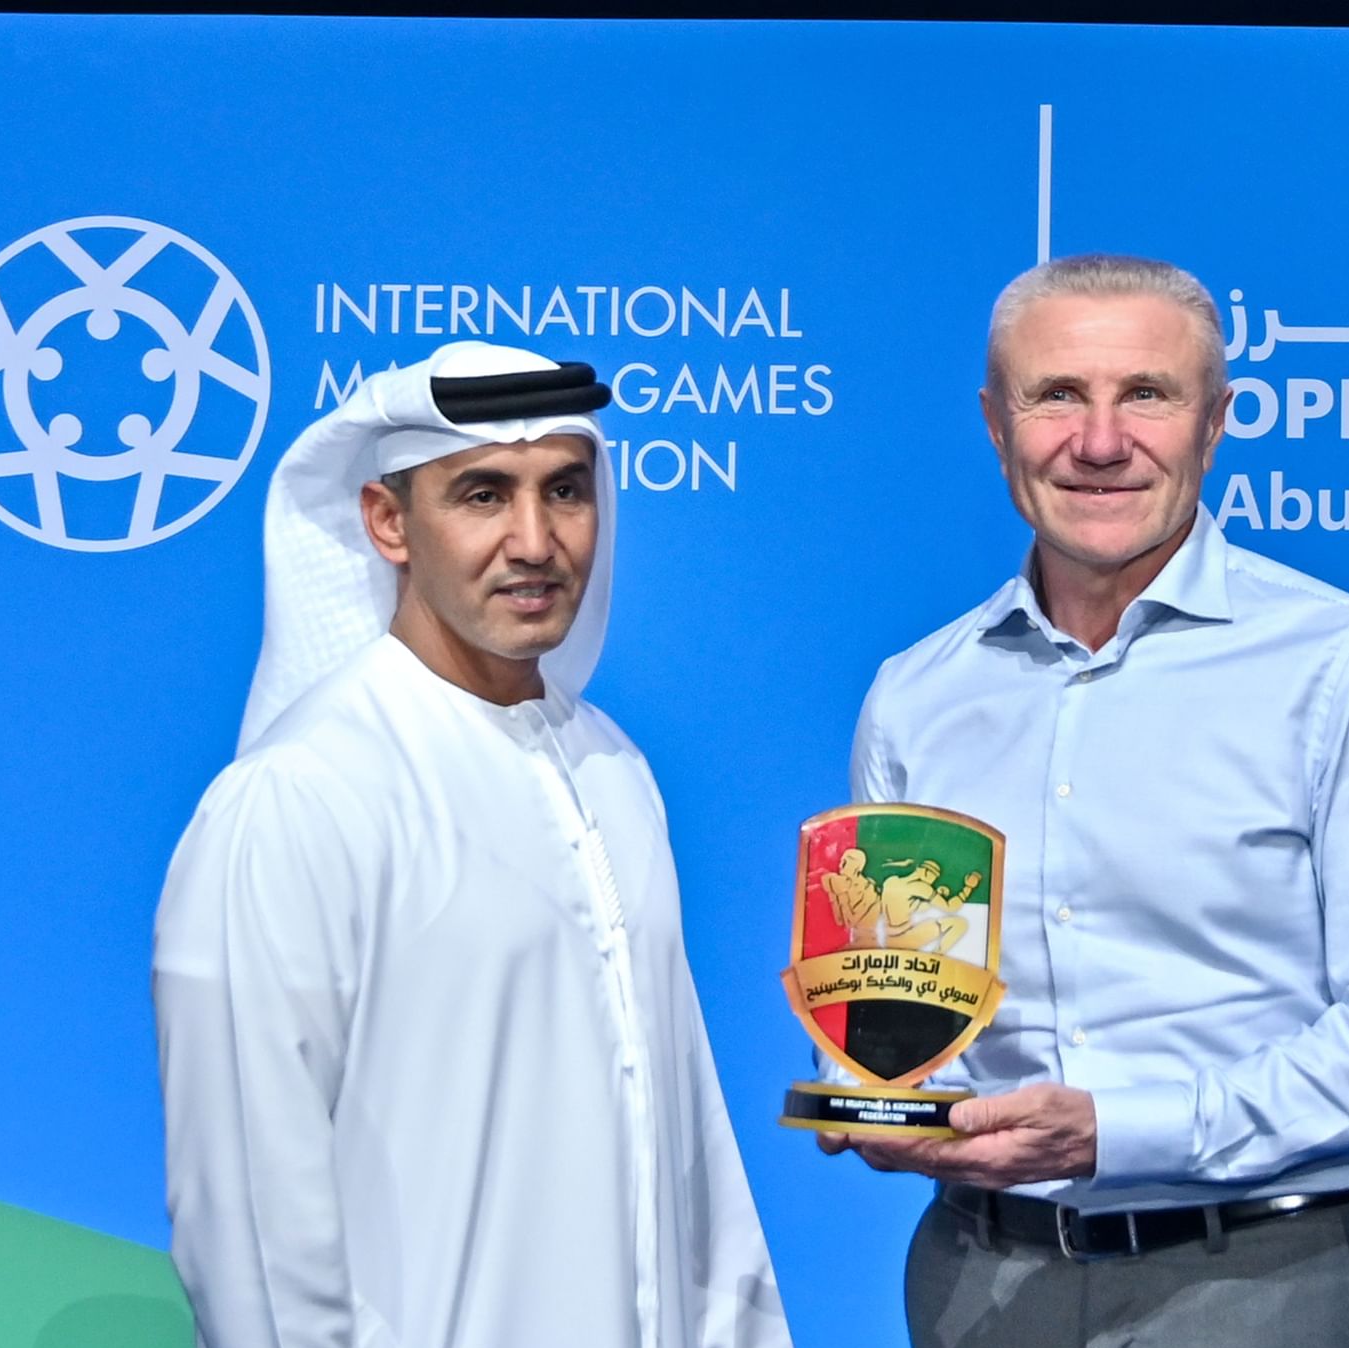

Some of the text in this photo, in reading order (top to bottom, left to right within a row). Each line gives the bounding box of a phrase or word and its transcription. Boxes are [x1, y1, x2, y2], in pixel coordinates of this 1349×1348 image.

[315, 283, 803, 338] INTERNATIONAL
[612, 362, 834, 417] GAMES
[842, 954, 941, 975] اتحاد الإمارات
